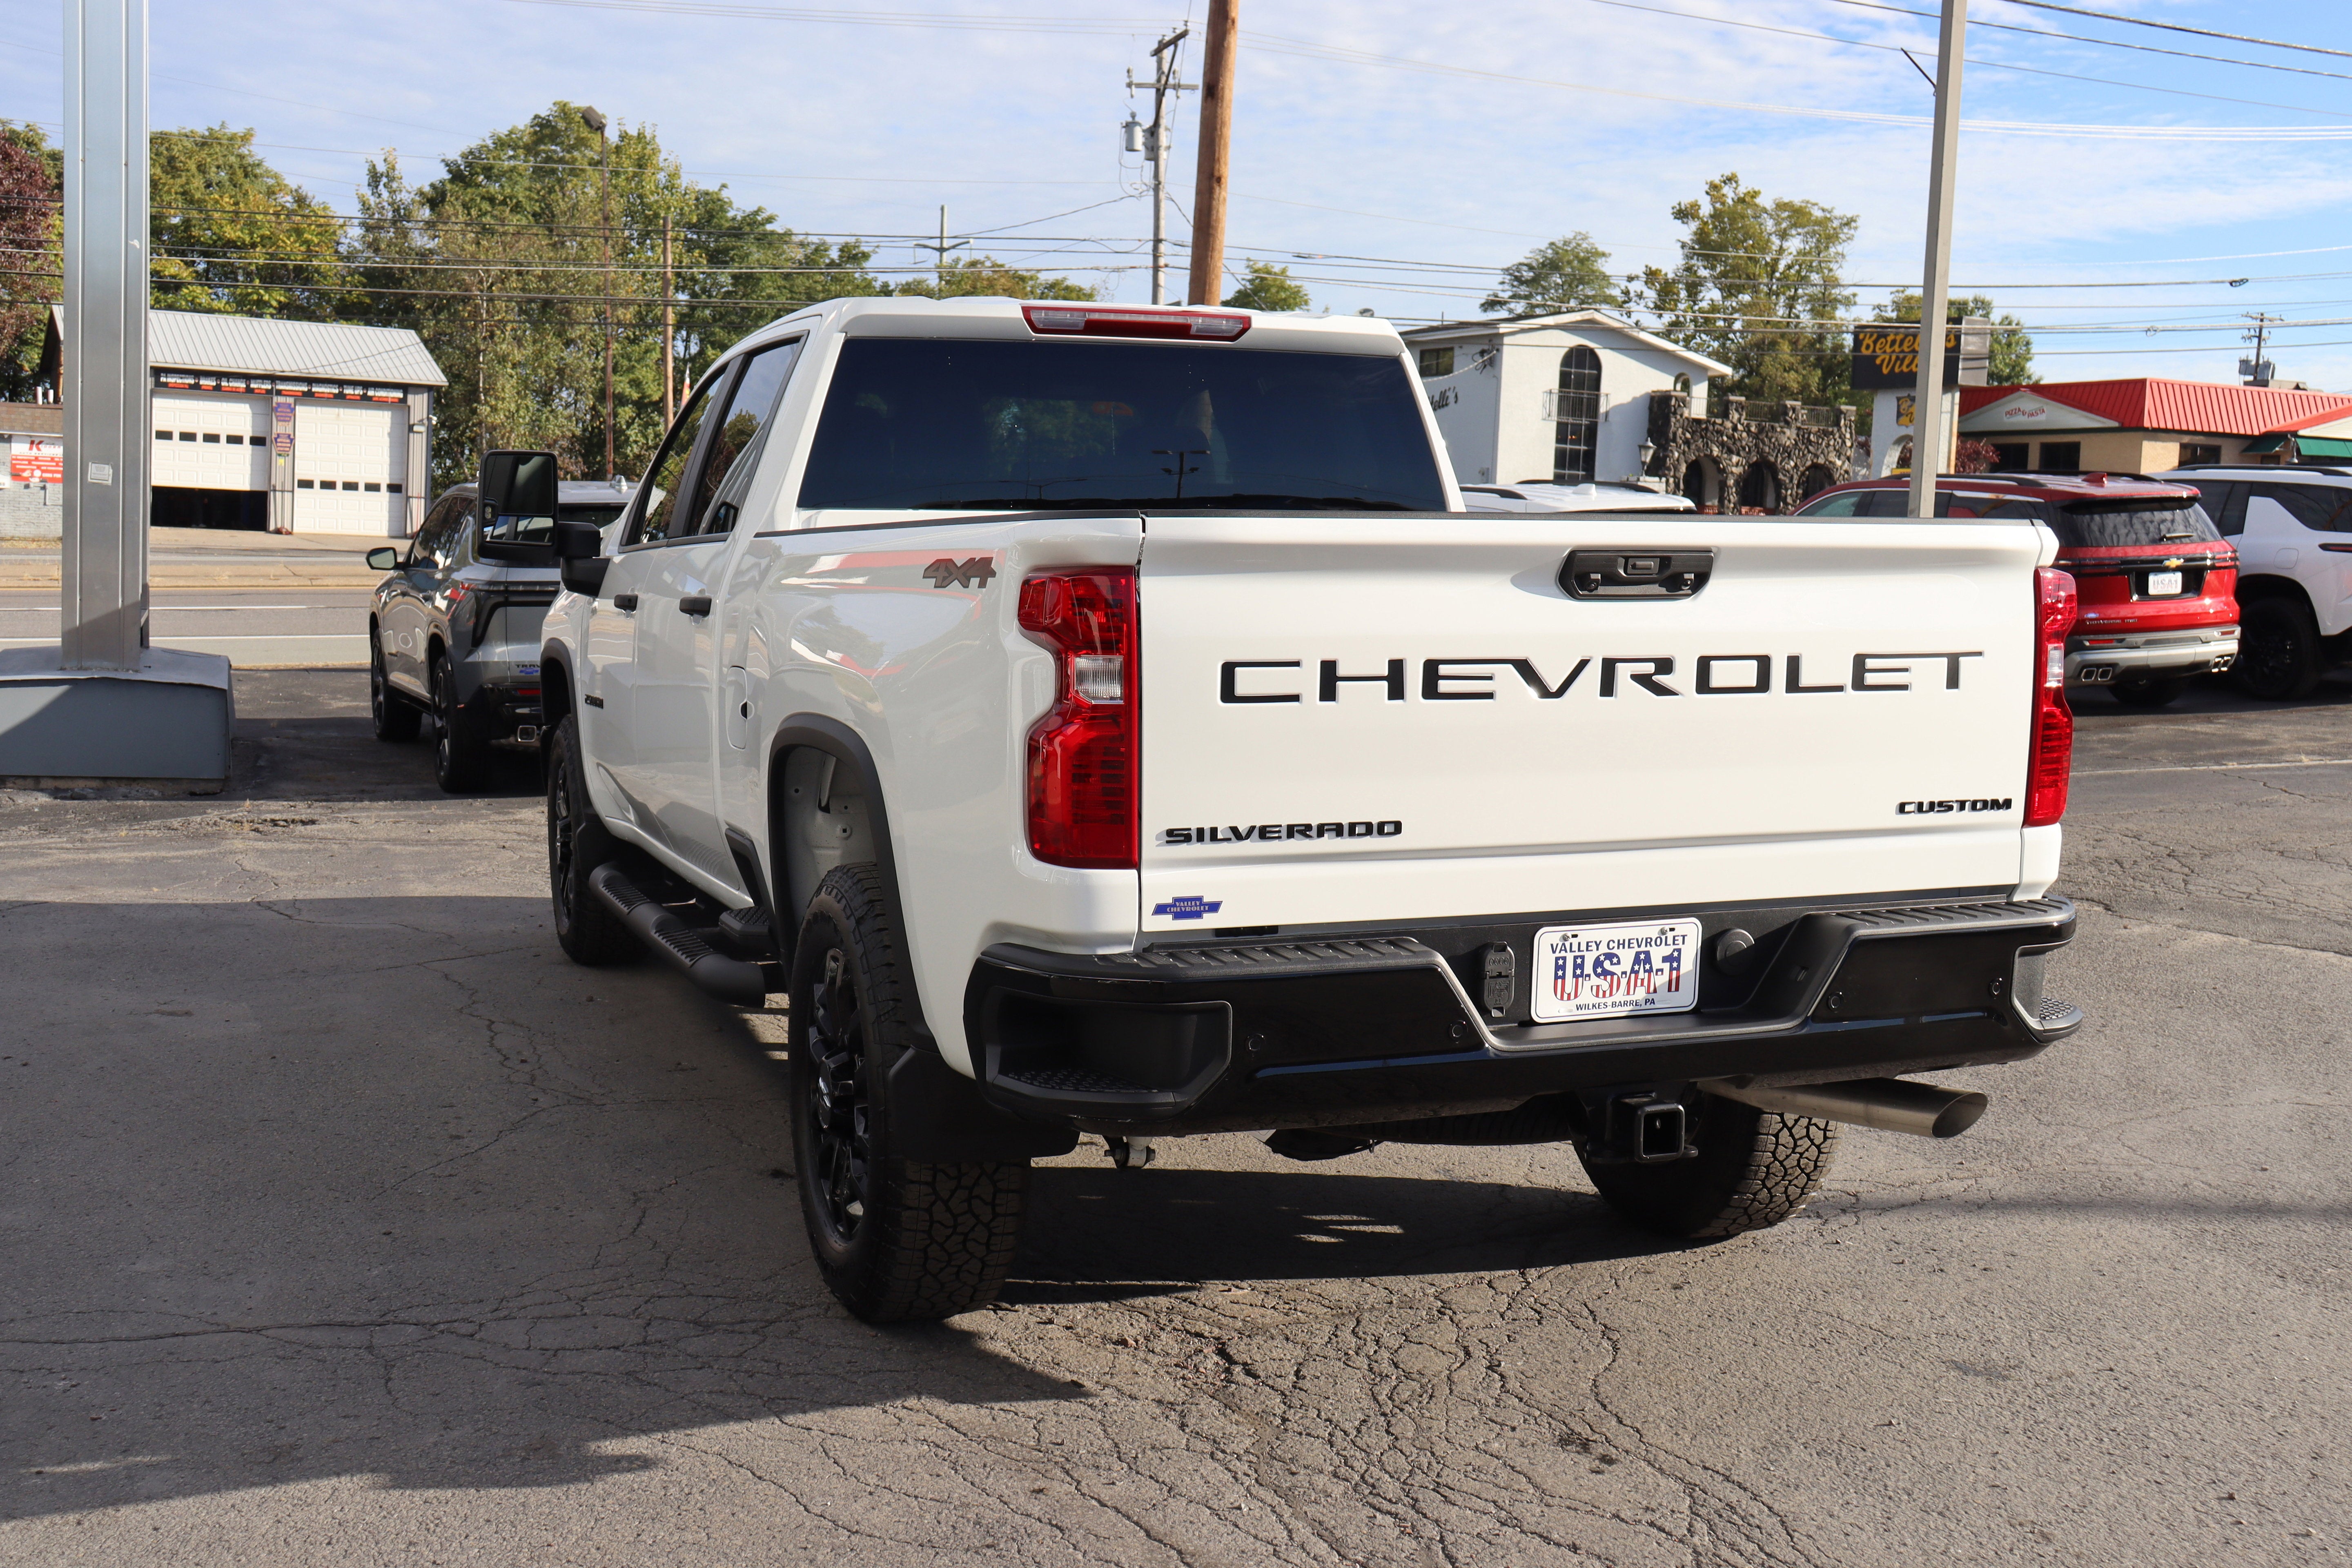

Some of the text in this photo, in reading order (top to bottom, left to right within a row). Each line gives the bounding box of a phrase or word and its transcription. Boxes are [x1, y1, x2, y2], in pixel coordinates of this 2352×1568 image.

[2005, 407, 2022, 417] PIZZA
[2027, 408, 2045, 419] PASTA
[1220, 651, 1983, 704] CHEVROLET
[1899, 798, 2012, 813] CUSTOM
[1165, 820, 1402, 844] SILVERADO
[1550, 934, 1688, 954] VALLEY CHEVROLET
[1575, 998, 1655, 1011] WILKES-BARRE, PA
